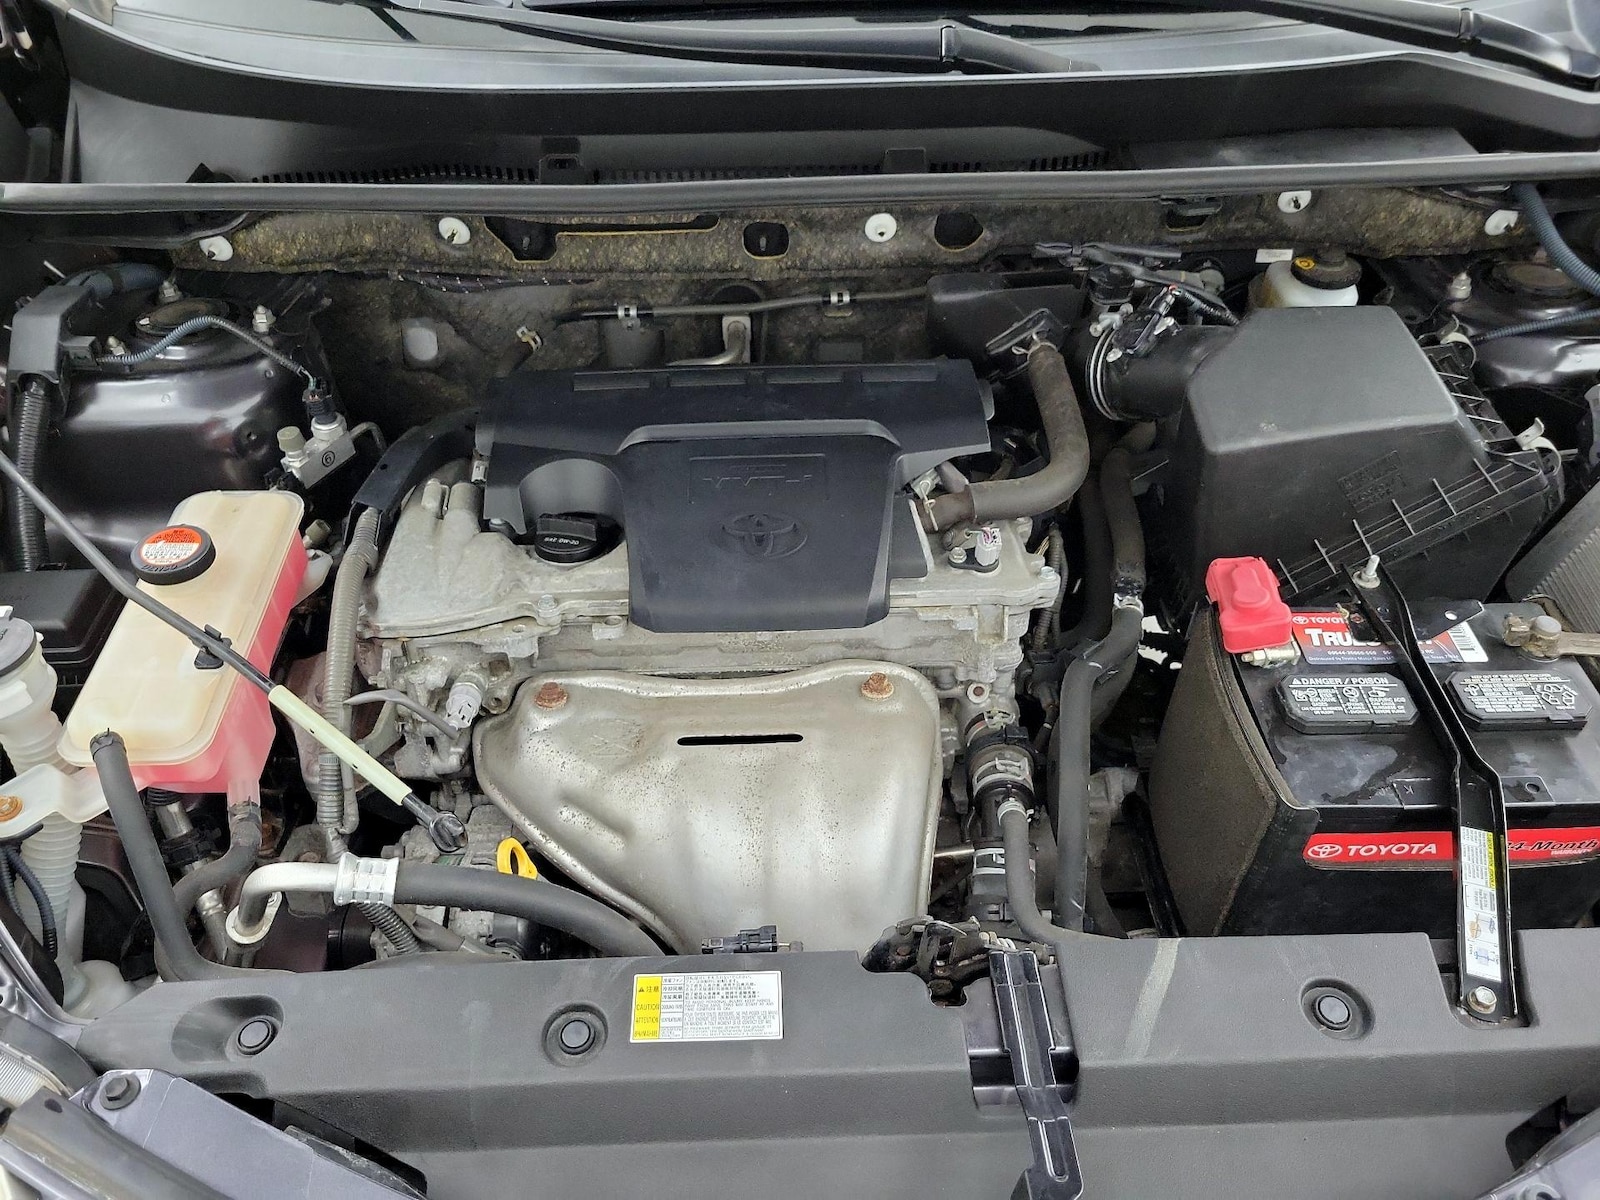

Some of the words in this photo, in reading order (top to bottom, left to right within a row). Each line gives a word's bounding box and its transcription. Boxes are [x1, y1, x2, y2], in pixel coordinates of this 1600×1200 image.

[1309, 616, 1348, 625] TOYOT
[1301, 677, 1343, 685] DANGER
[1351, 677, 1389, 685] POISON
[1347, 843, 1437, 856] TOYOTA
[636, 1003, 660, 1011] CAUTION
[635, 1016, 659, 1024] ATTENTION
